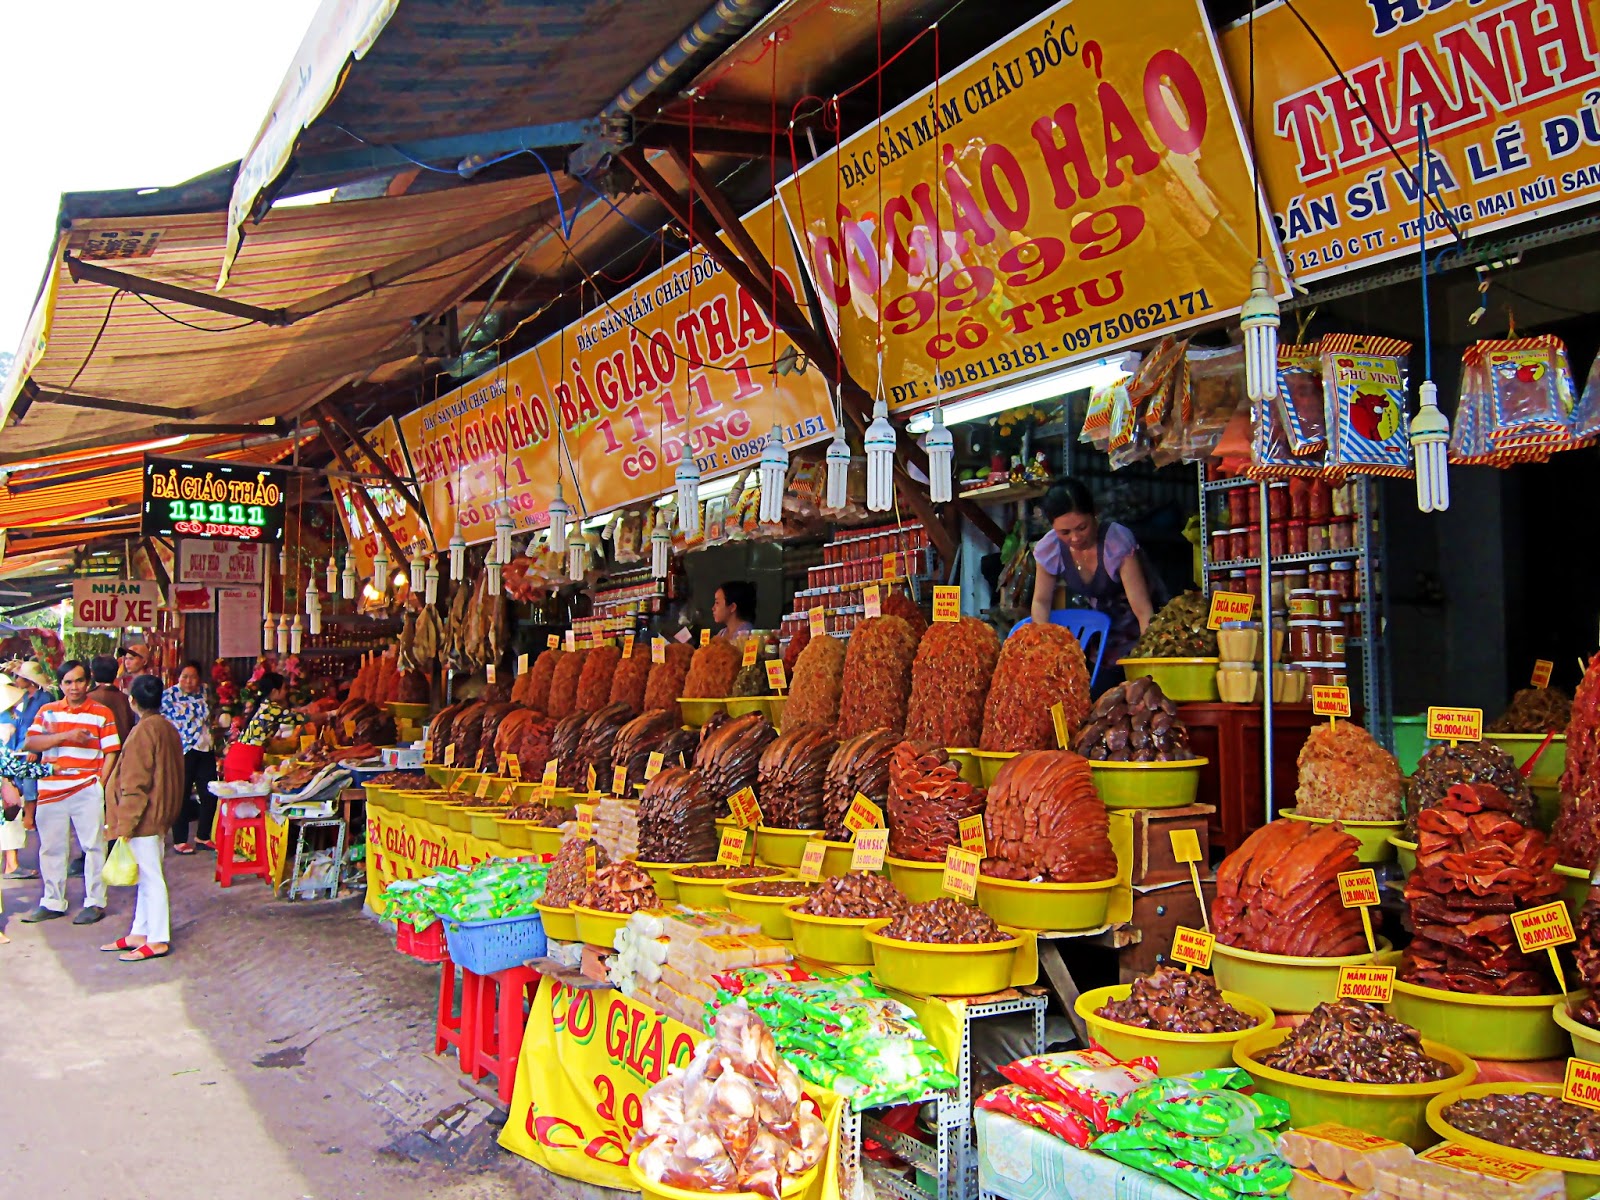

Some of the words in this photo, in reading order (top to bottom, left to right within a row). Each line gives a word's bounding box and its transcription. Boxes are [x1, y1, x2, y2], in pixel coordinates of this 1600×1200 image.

[840, 153, 876, 189] ĐẶC
[879, 126, 914, 168] SẢN
[917, 94, 963, 146] MẮM
[964, 61, 1024, 115] CHÂU
[1025, 19, 1079, 79] ĐỐC
[814, 202, 880, 307] CÔ
[884, 143, 1030, 276] GIÁO
[1031, 40, 1207, 210] HẢO
[1346, 170, 1388, 219] SĨ
[1467, 124, 1528, 180] LẼ
[1300, 252, 1319, 269] 12
[1322, 240, 1344, 262] LÔ
[1348, 238, 1360, 254] C
[1363, 230, 1384, 249] TT
[1478, 190, 1516, 217] MẠI
[1520, 175, 1557, 204] NÚI
[884, 205, 1146, 335] 9999
[577, 326, 599, 351] ĐẶC
[600, 310, 624, 338] SẢN
[655, 272, 690, 306] CHÂU
[926, 316, 989, 359] CÔ
[1001, 271, 1125, 334] THU
[934, 341, 1049, 391] 0918113181
[1062, 288, 1214, 353] 0975062171
[555, 361, 599, 430] BÀ
[596, 329, 676, 409] GIÁO
[1370, 373, 1399, 385] VINH
[623, 445, 657, 478] CÔ
[228, 473, 279, 506] THẢO
[169, 500, 265, 526] 11111
[175, 519, 203, 534] CÔ
[206, 522, 261, 537] DUNG
[459, 503, 480, 526] CÔ
[92, 584, 141, 595] NHẬN
[79, 593, 119, 622] GIỮ
[125, 600, 152, 621] XE
[1230, 602, 1249, 614] GANG
[386, 825, 416, 860] GIÁO
